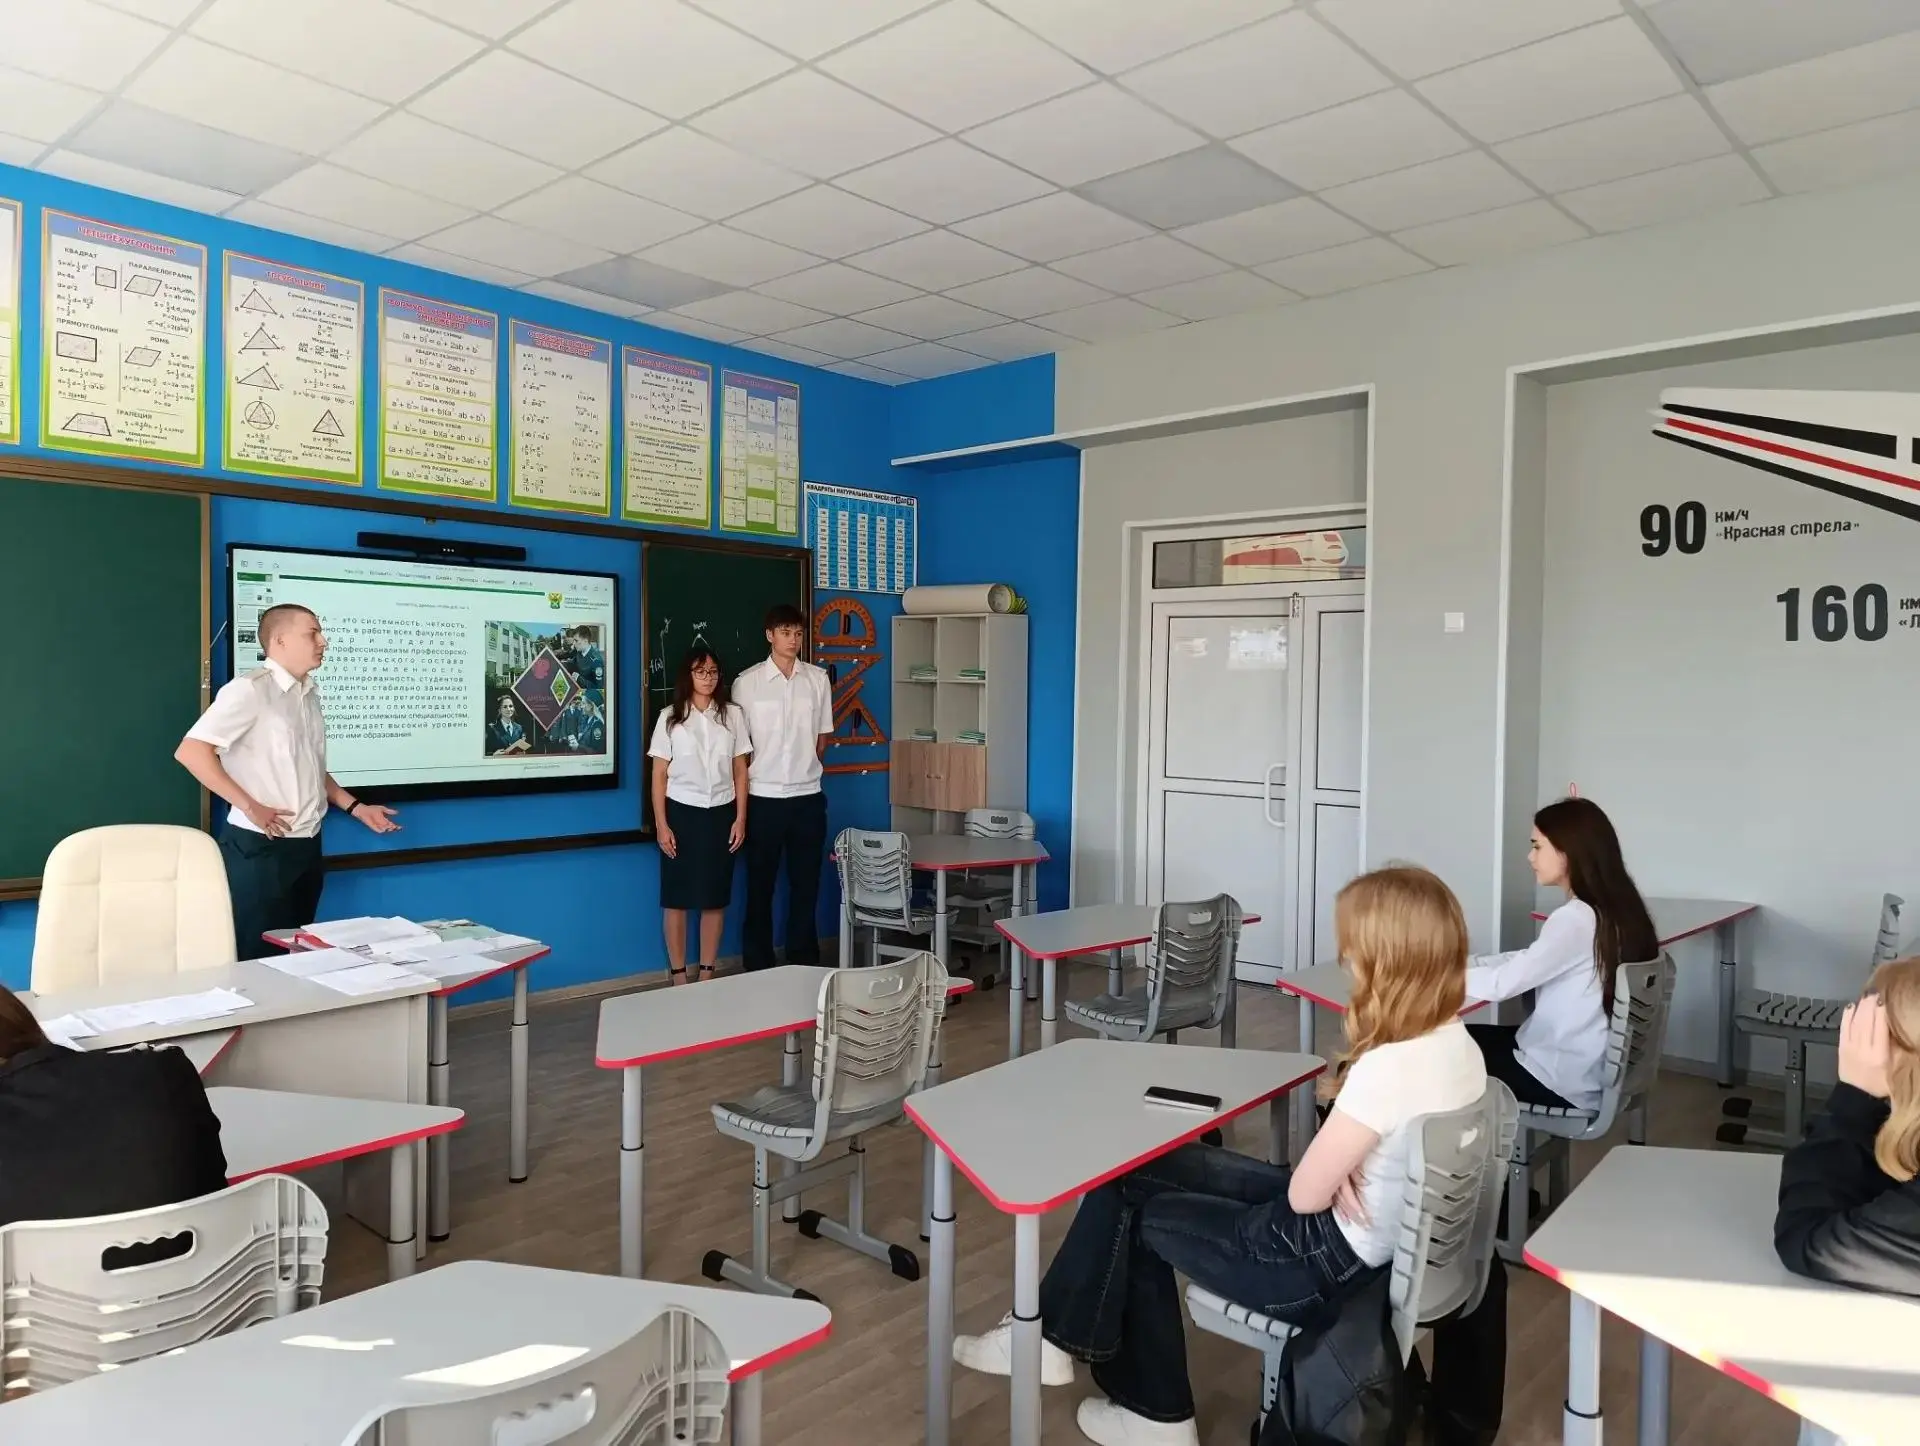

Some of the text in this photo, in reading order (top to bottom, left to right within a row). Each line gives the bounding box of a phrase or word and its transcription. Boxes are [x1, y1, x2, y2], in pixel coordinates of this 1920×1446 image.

[64, 247, 98, 258] КВАДРАТ
[128, 261, 192, 280] ПАРАЛЛЕЛОГРАММ
[150, 336, 170, 344] РОМБ
[806, 484, 836, 494] КВАДРАТЫ
[836, 487, 874, 498] НАТУРАЛЬНЫХ
[1640, 500, 1749, 557] 90 км/ч
[1716, 520, 1860, 542] «Красная стрела»
[1776, 583, 1888, 642] 160
[362, 627, 391, 636] работе
[388, 638, 454, 646] отделов
[332, 646, 408, 654] профессионализм
[321, 656, 416, 664] одавательского
[323, 684, 368, 692] студенты
